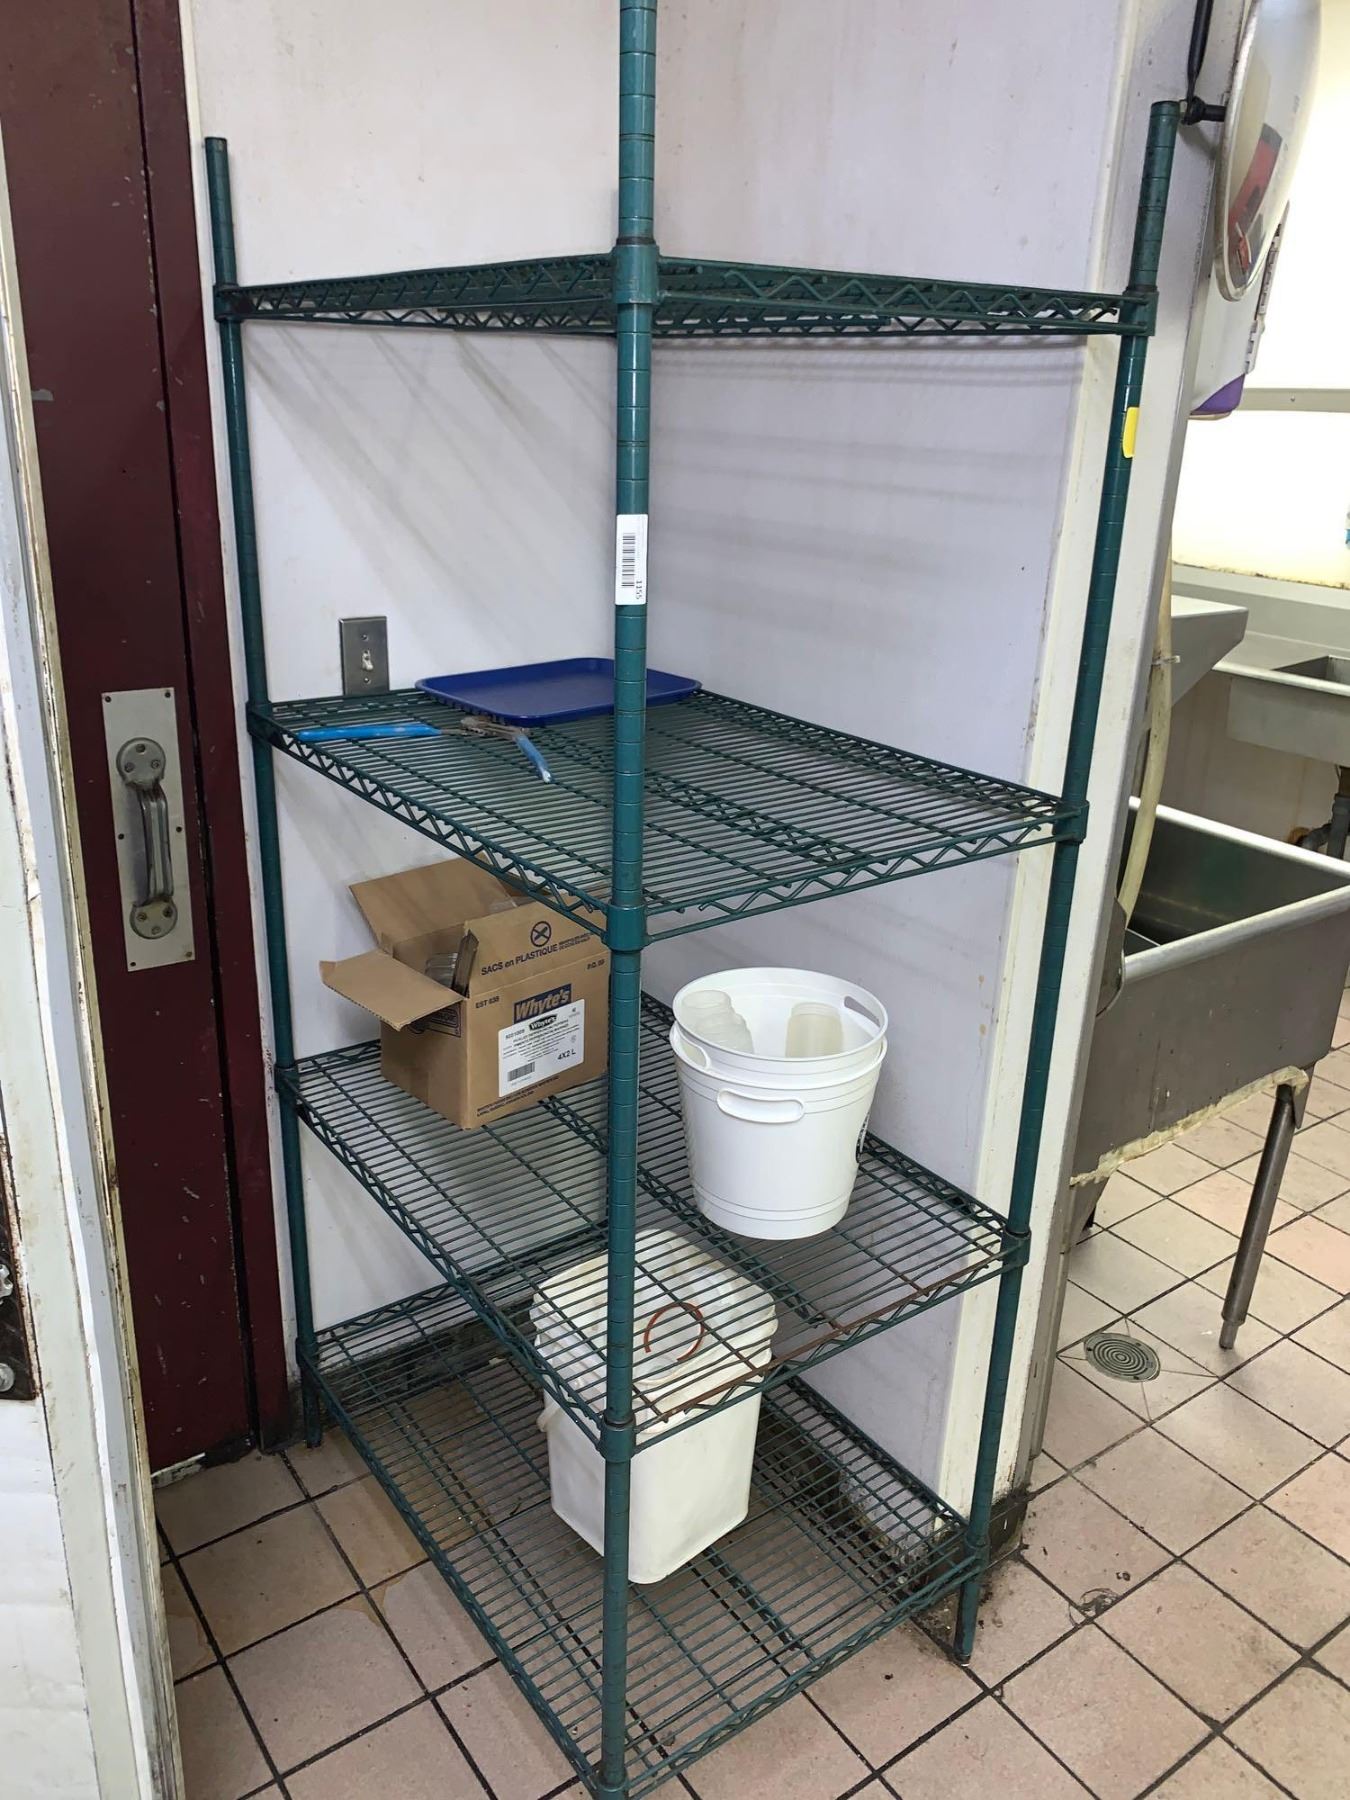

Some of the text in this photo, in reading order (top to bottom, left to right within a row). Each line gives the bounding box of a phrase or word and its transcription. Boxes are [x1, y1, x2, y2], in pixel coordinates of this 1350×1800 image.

[481, 944, 558, 976] SACS en PLASTIQUE
[515, 987, 571, 1021] Whyte's
